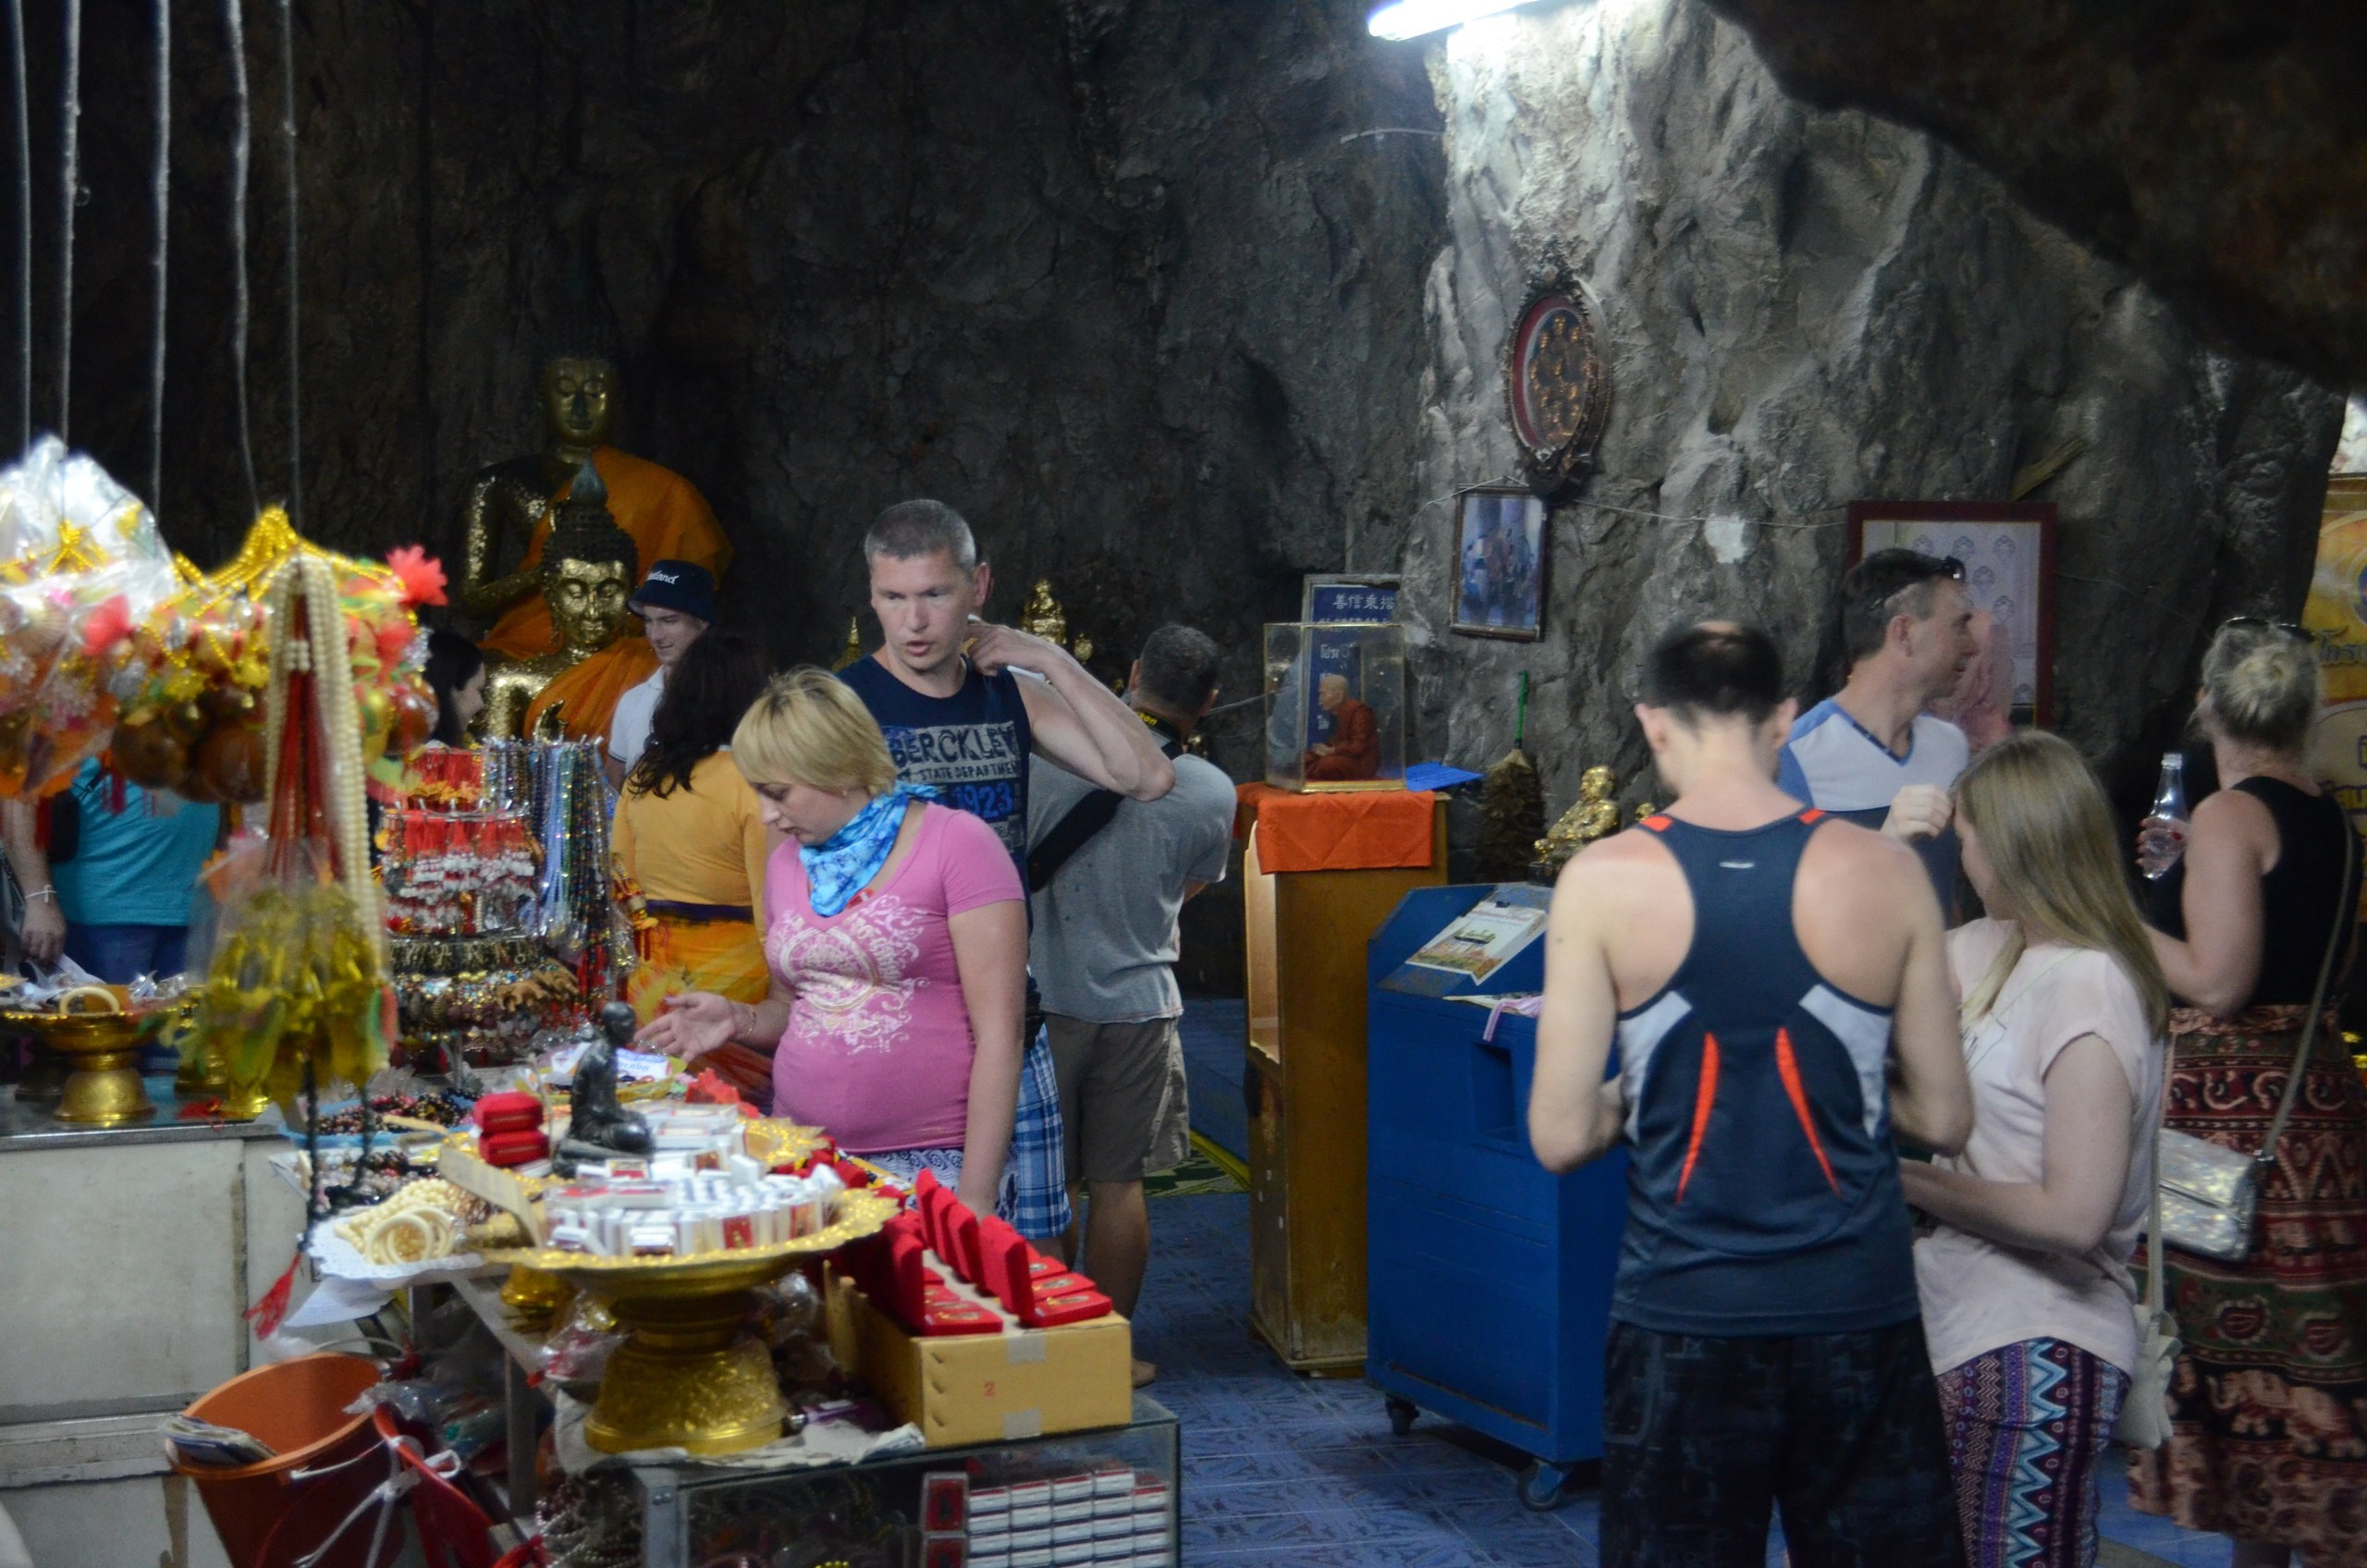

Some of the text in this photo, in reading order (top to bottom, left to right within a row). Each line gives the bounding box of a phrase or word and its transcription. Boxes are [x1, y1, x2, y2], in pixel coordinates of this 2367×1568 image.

[887, 725, 1014, 767] BERCKLEY
[920, 766, 952, 781] STATE
[951, 782, 1014, 819] 1923
[983, 1381, 996, 1397] 2
